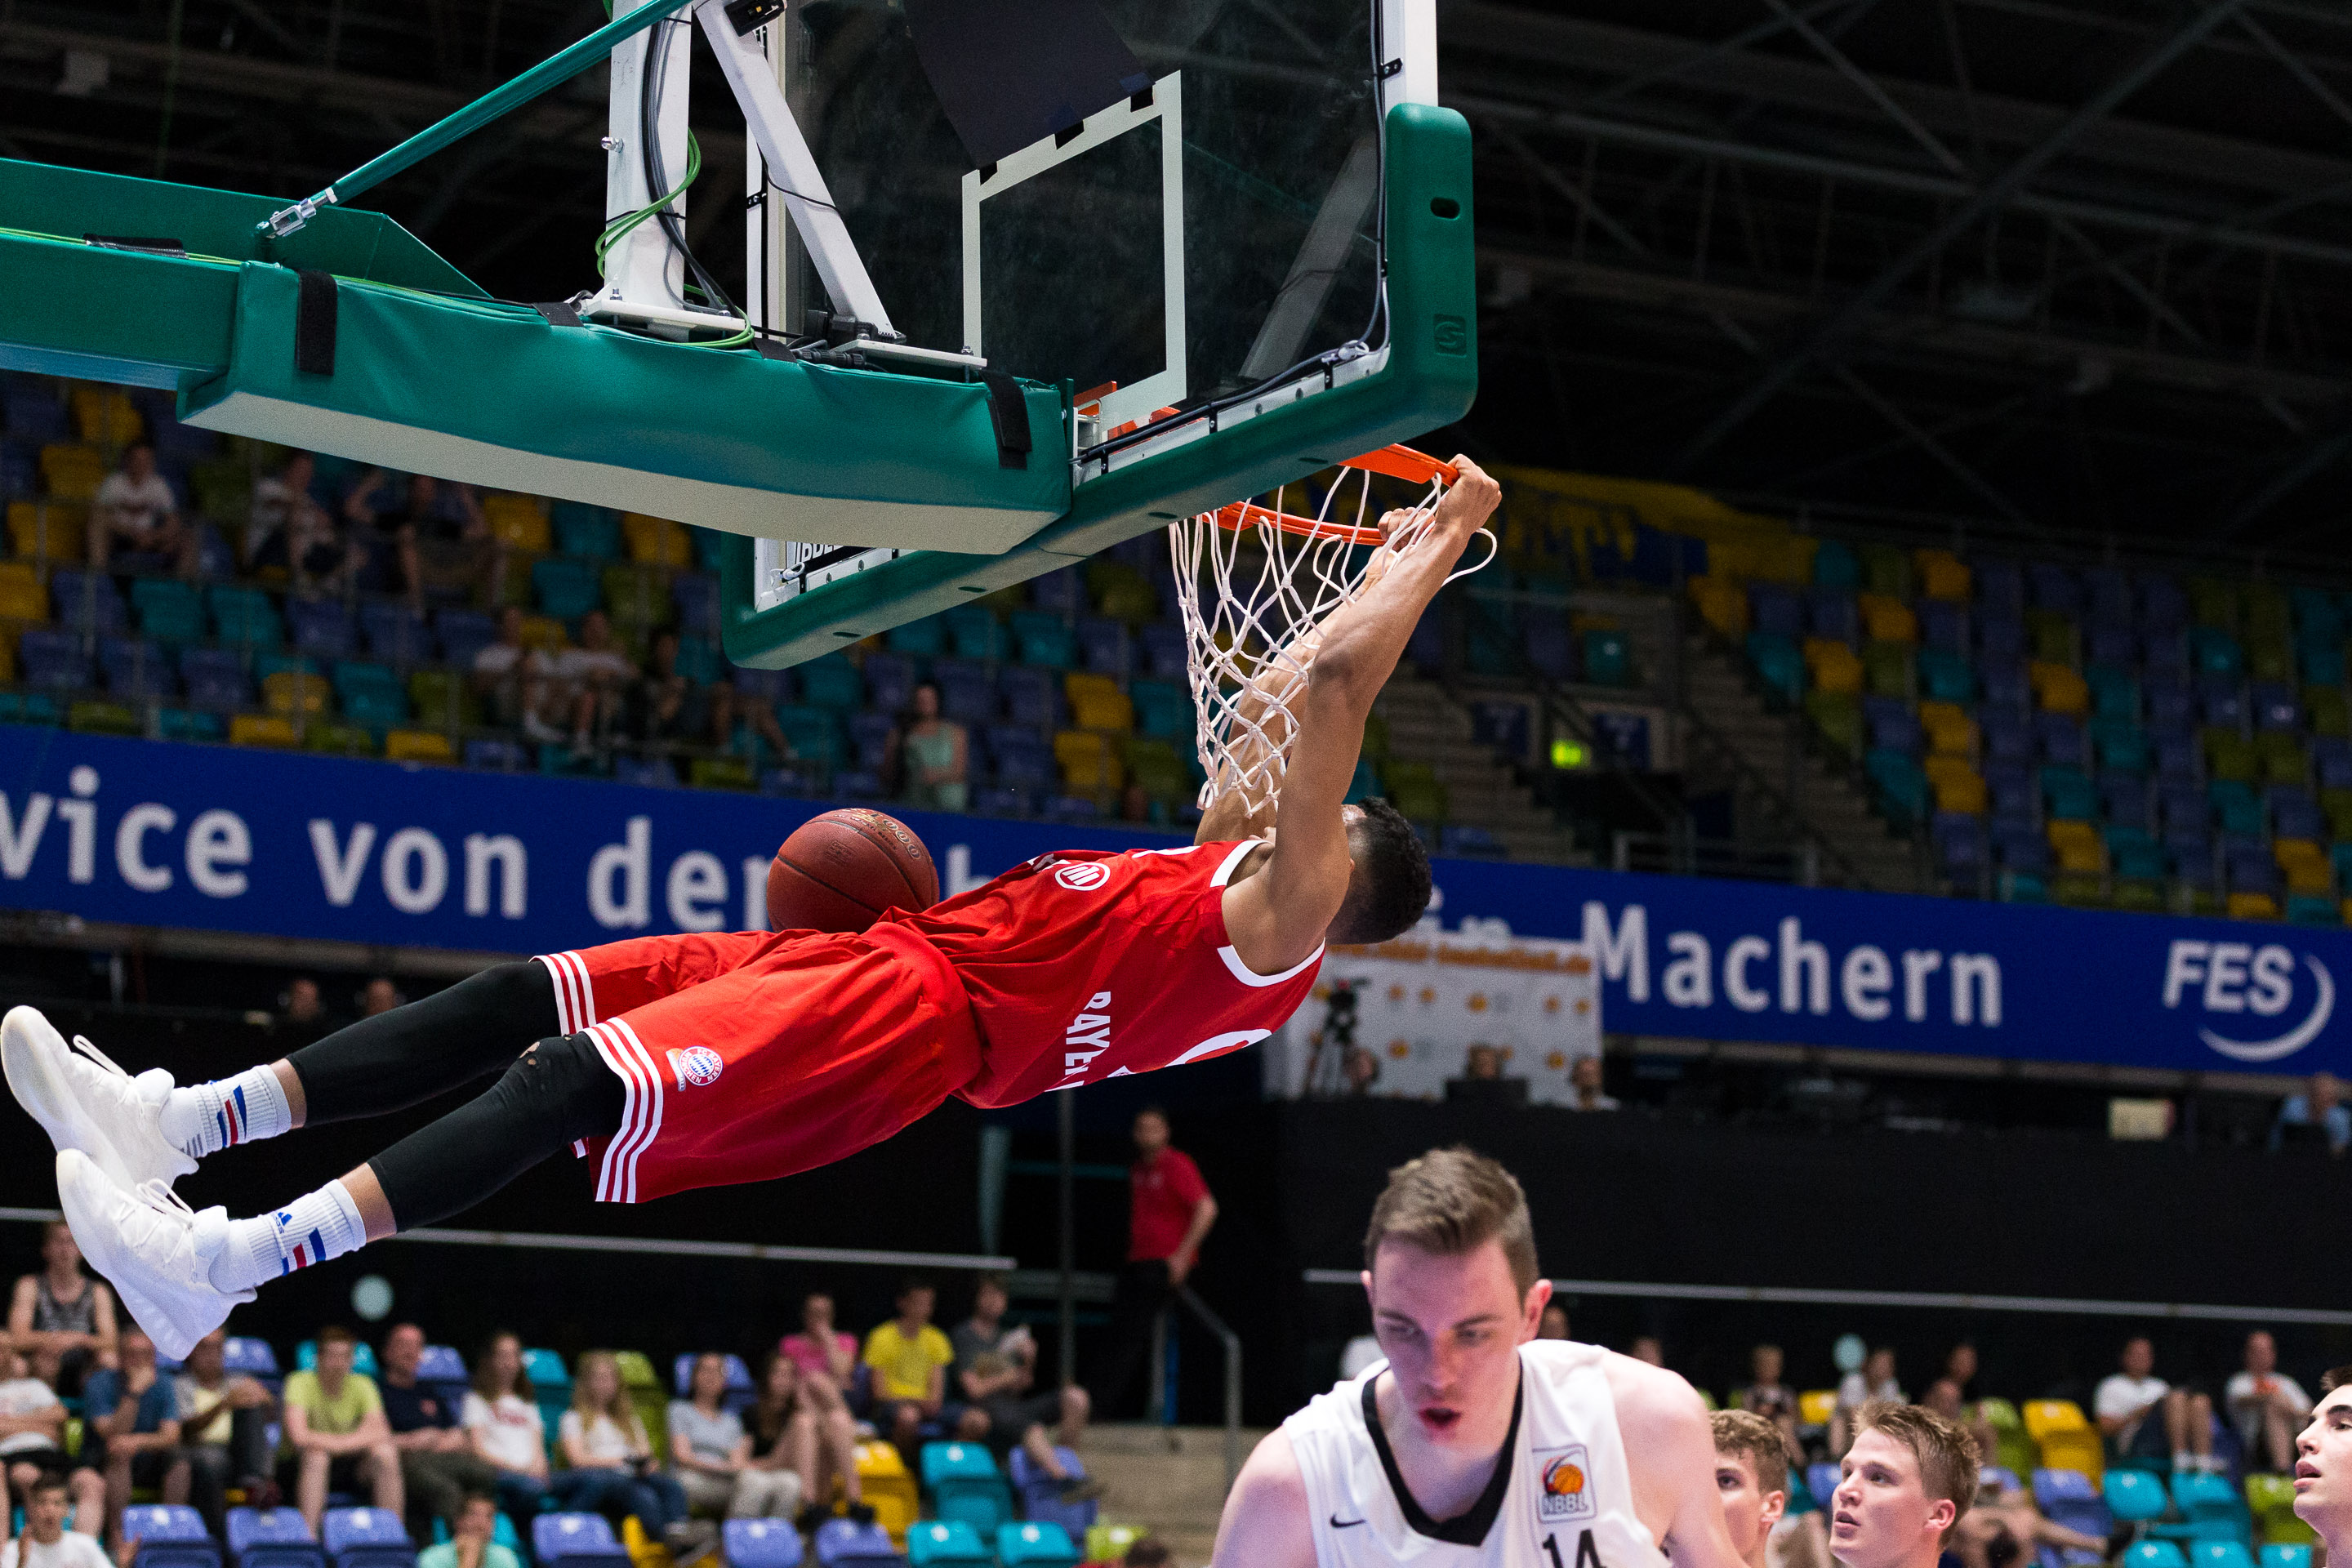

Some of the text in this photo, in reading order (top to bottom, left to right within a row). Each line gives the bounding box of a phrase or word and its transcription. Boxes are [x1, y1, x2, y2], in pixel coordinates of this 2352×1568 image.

[0, 764, 254, 898] vice
[308, 817, 528, 920] von
[1582, 900, 2003, 1027] Machern
[2162, 939, 2296, 1016] FES
